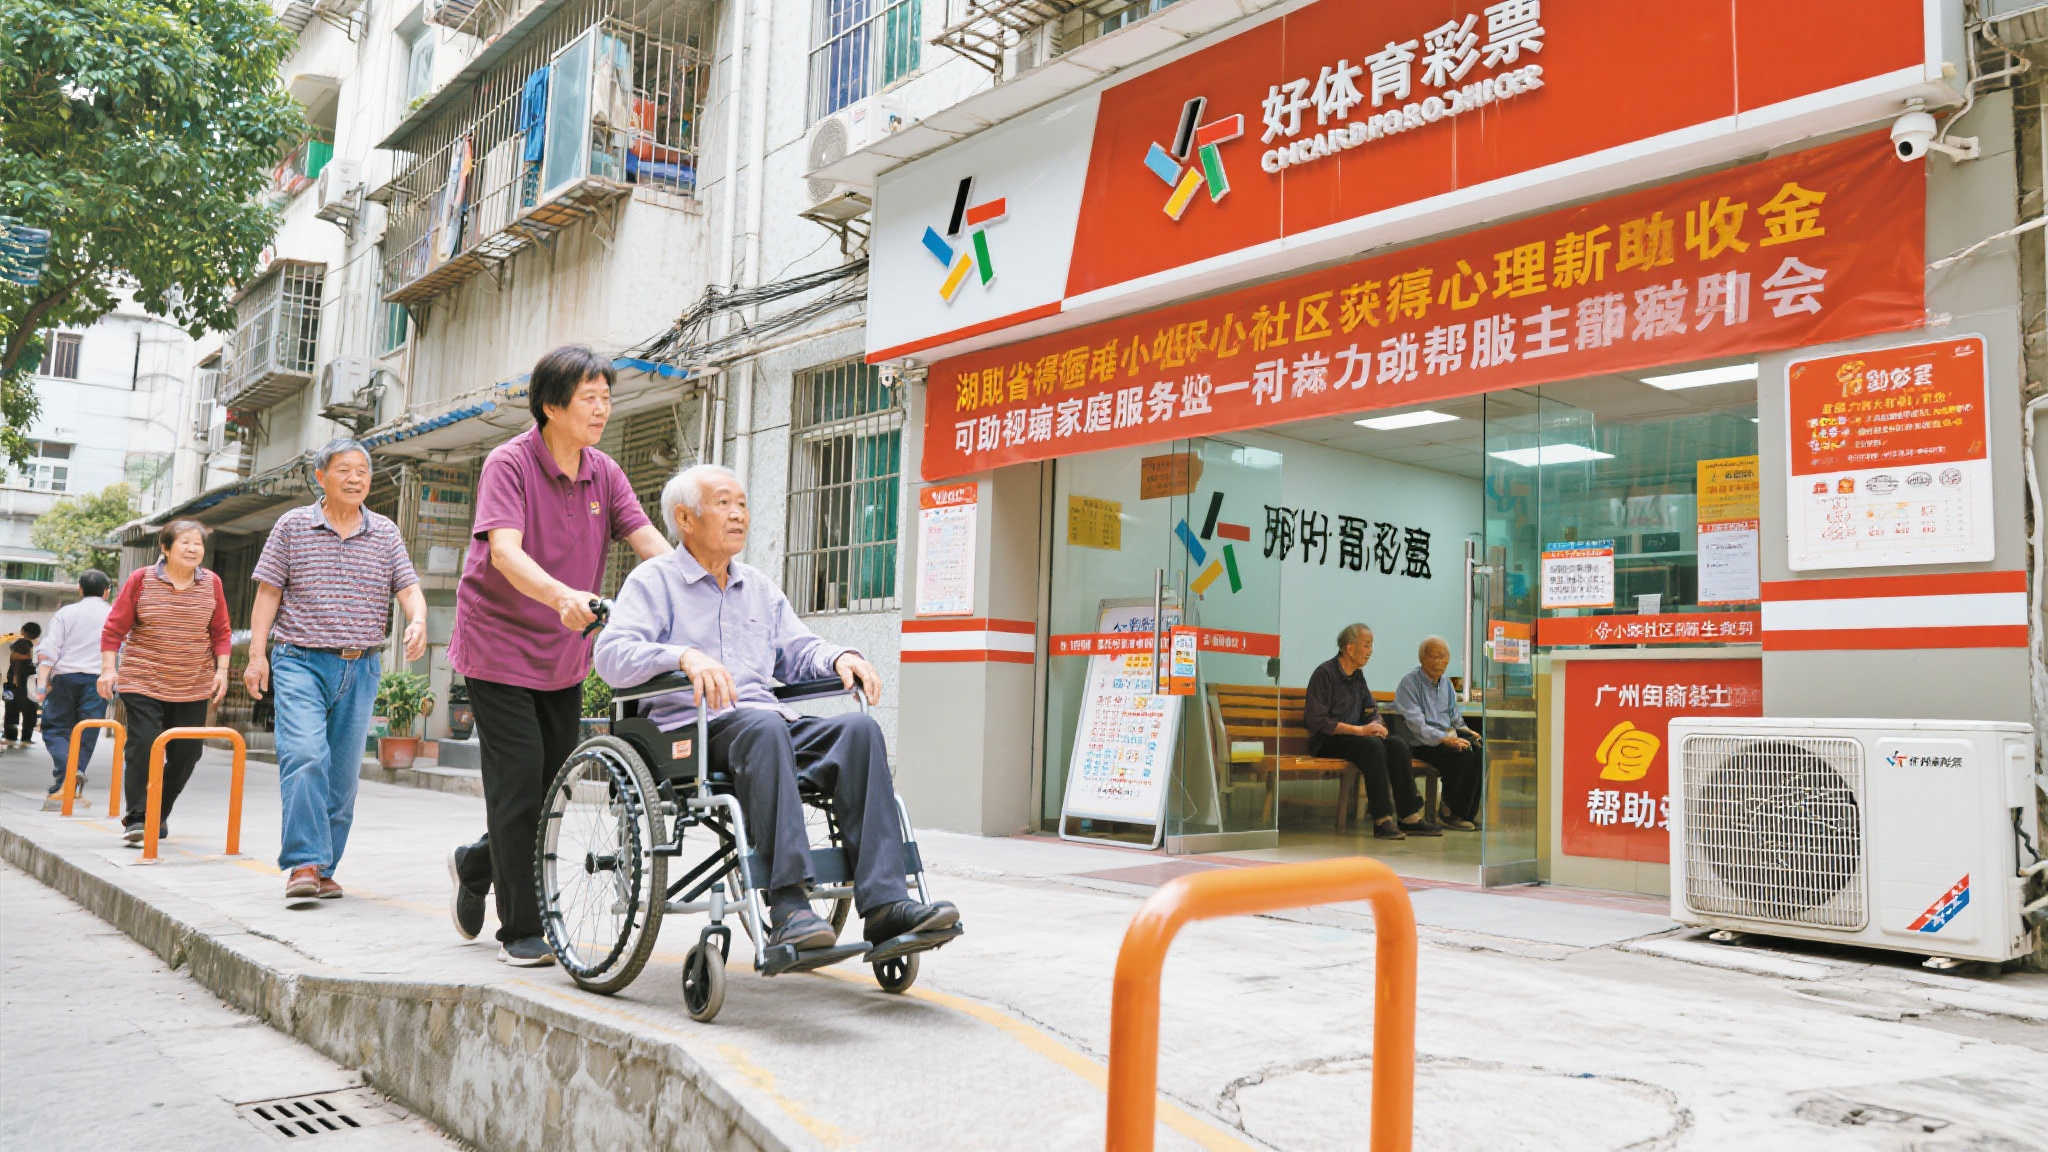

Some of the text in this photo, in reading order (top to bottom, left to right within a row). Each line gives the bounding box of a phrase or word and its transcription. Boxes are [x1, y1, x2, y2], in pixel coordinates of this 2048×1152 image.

[1260, 0, 1546, 145] 好体育彩票
